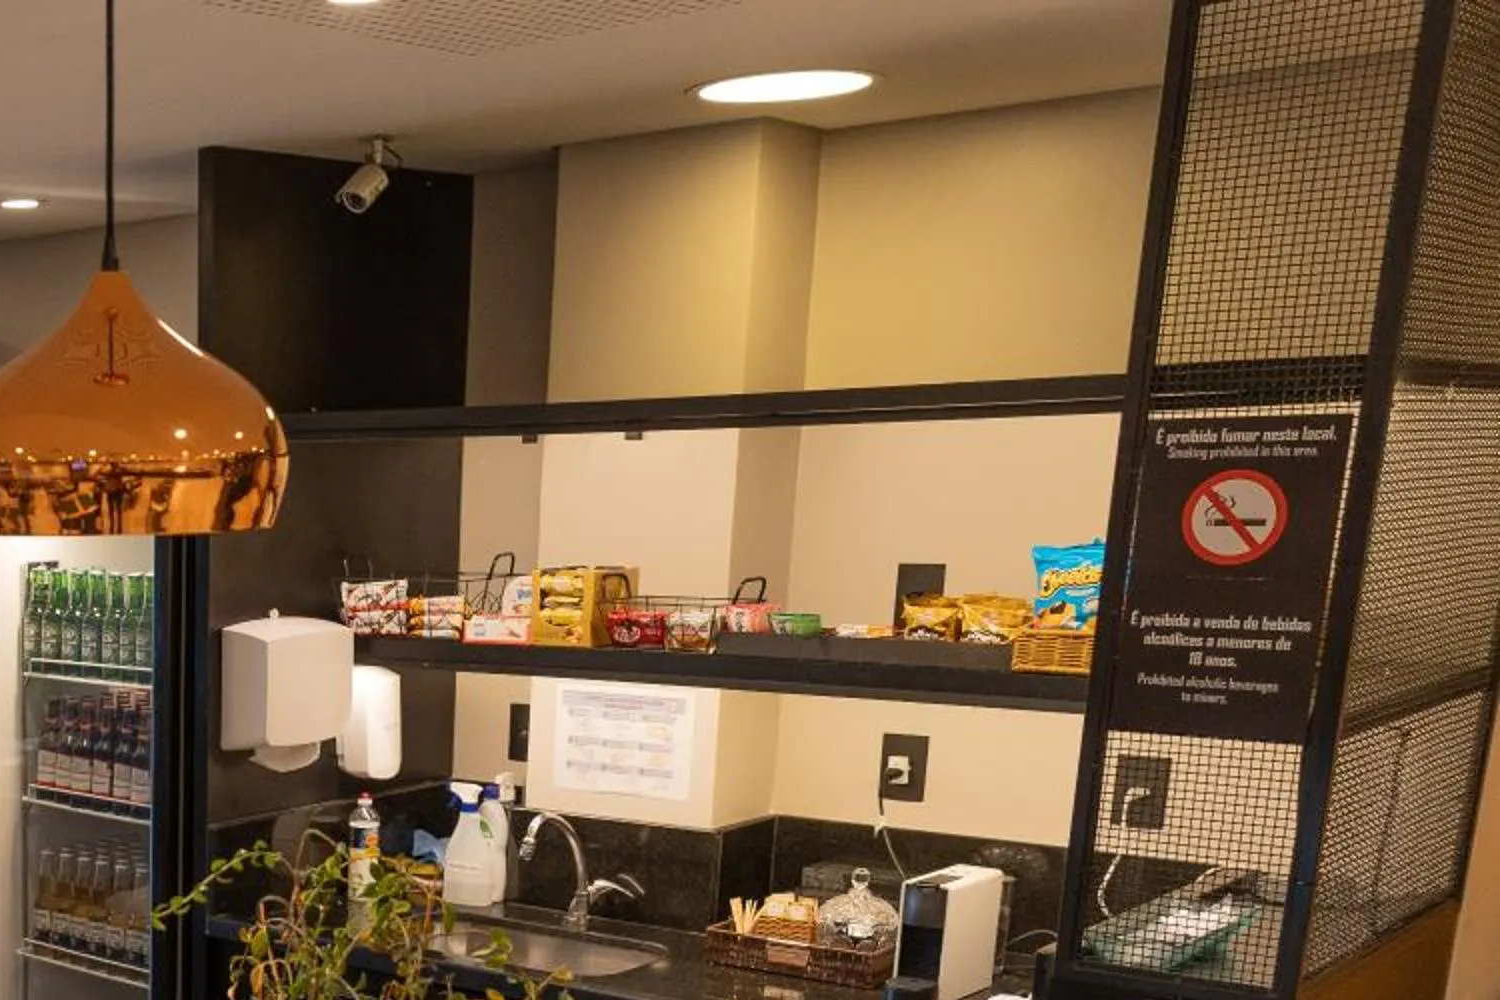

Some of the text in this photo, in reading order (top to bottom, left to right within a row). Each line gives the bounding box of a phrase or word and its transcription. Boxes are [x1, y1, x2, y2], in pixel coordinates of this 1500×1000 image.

[1166, 426, 1218, 447] proibido
[1221, 427, 1261, 443] fumar
[1263, 427, 1299, 442] neste
[1301, 425, 1337, 441] local.
[1140, 611, 1190, 630] proibida
[1193, 616, 1201, 628] a
[1204, 615, 1241, 630] venda
[1243, 614, 1259, 631] de
[1261, 616, 1312, 633] bebidas
[1206, 636, 1214, 646] a
[1216, 637, 1272, 650] menores
[1275, 636, 1292, 651] de
